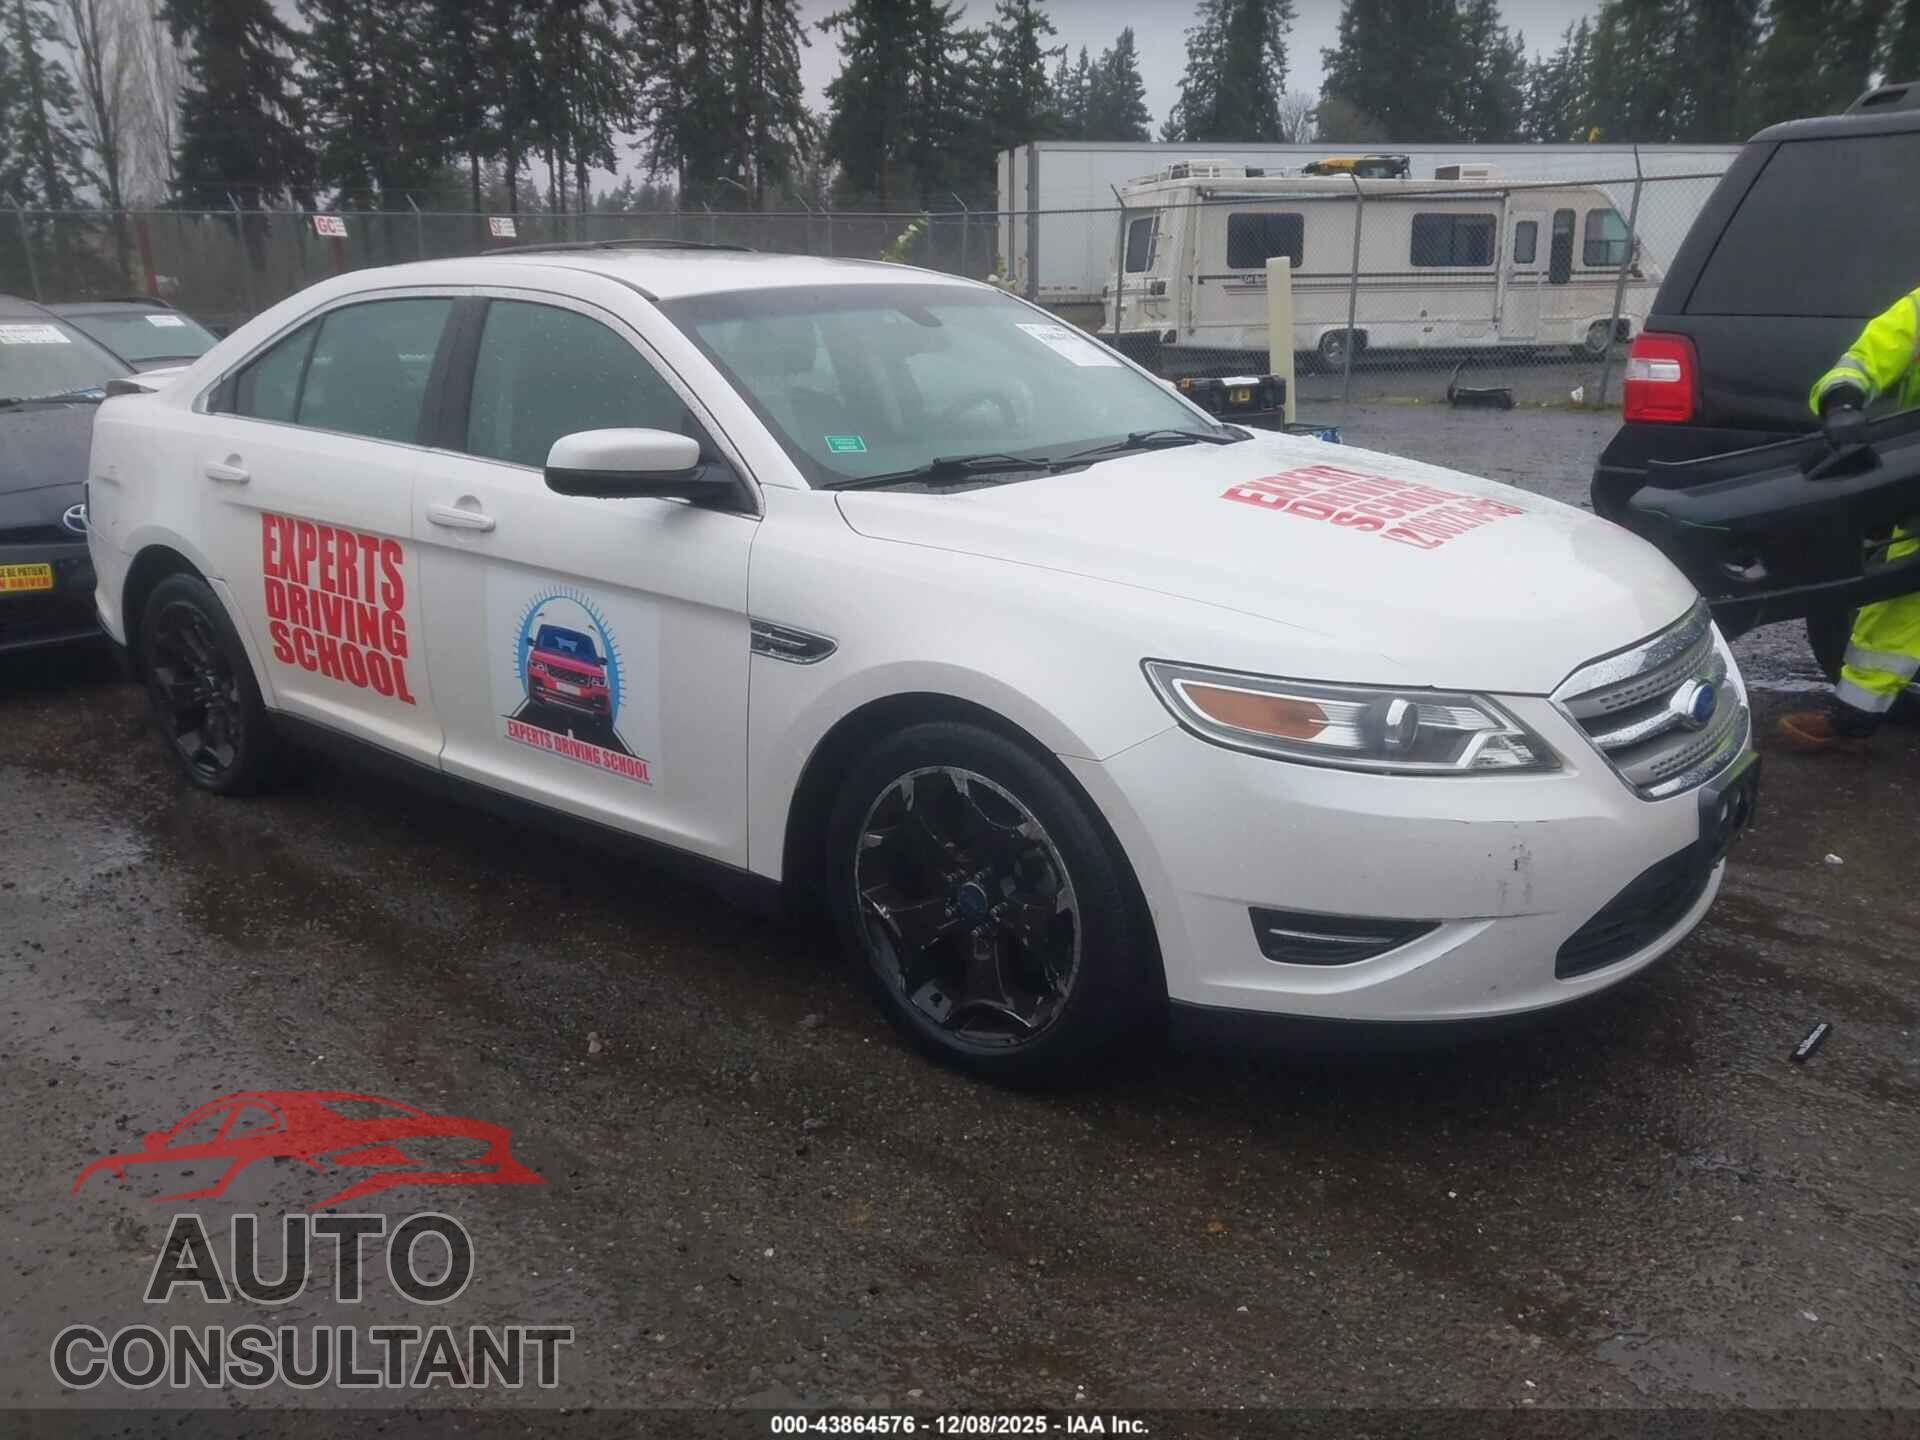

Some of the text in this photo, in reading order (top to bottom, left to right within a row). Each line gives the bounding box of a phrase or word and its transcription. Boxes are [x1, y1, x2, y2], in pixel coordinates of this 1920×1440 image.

[1283, 476, 1412, 521] DRIVIN
[1329, 484, 1472, 532] SCHOO
[262, 513, 404, 612] EXPERTS
[264, 577, 408, 659] DRIVING
[270, 620, 416, 706] SCHOOL
[507, 719, 650, 780] EXPERTS DRIVING SCHOOL
